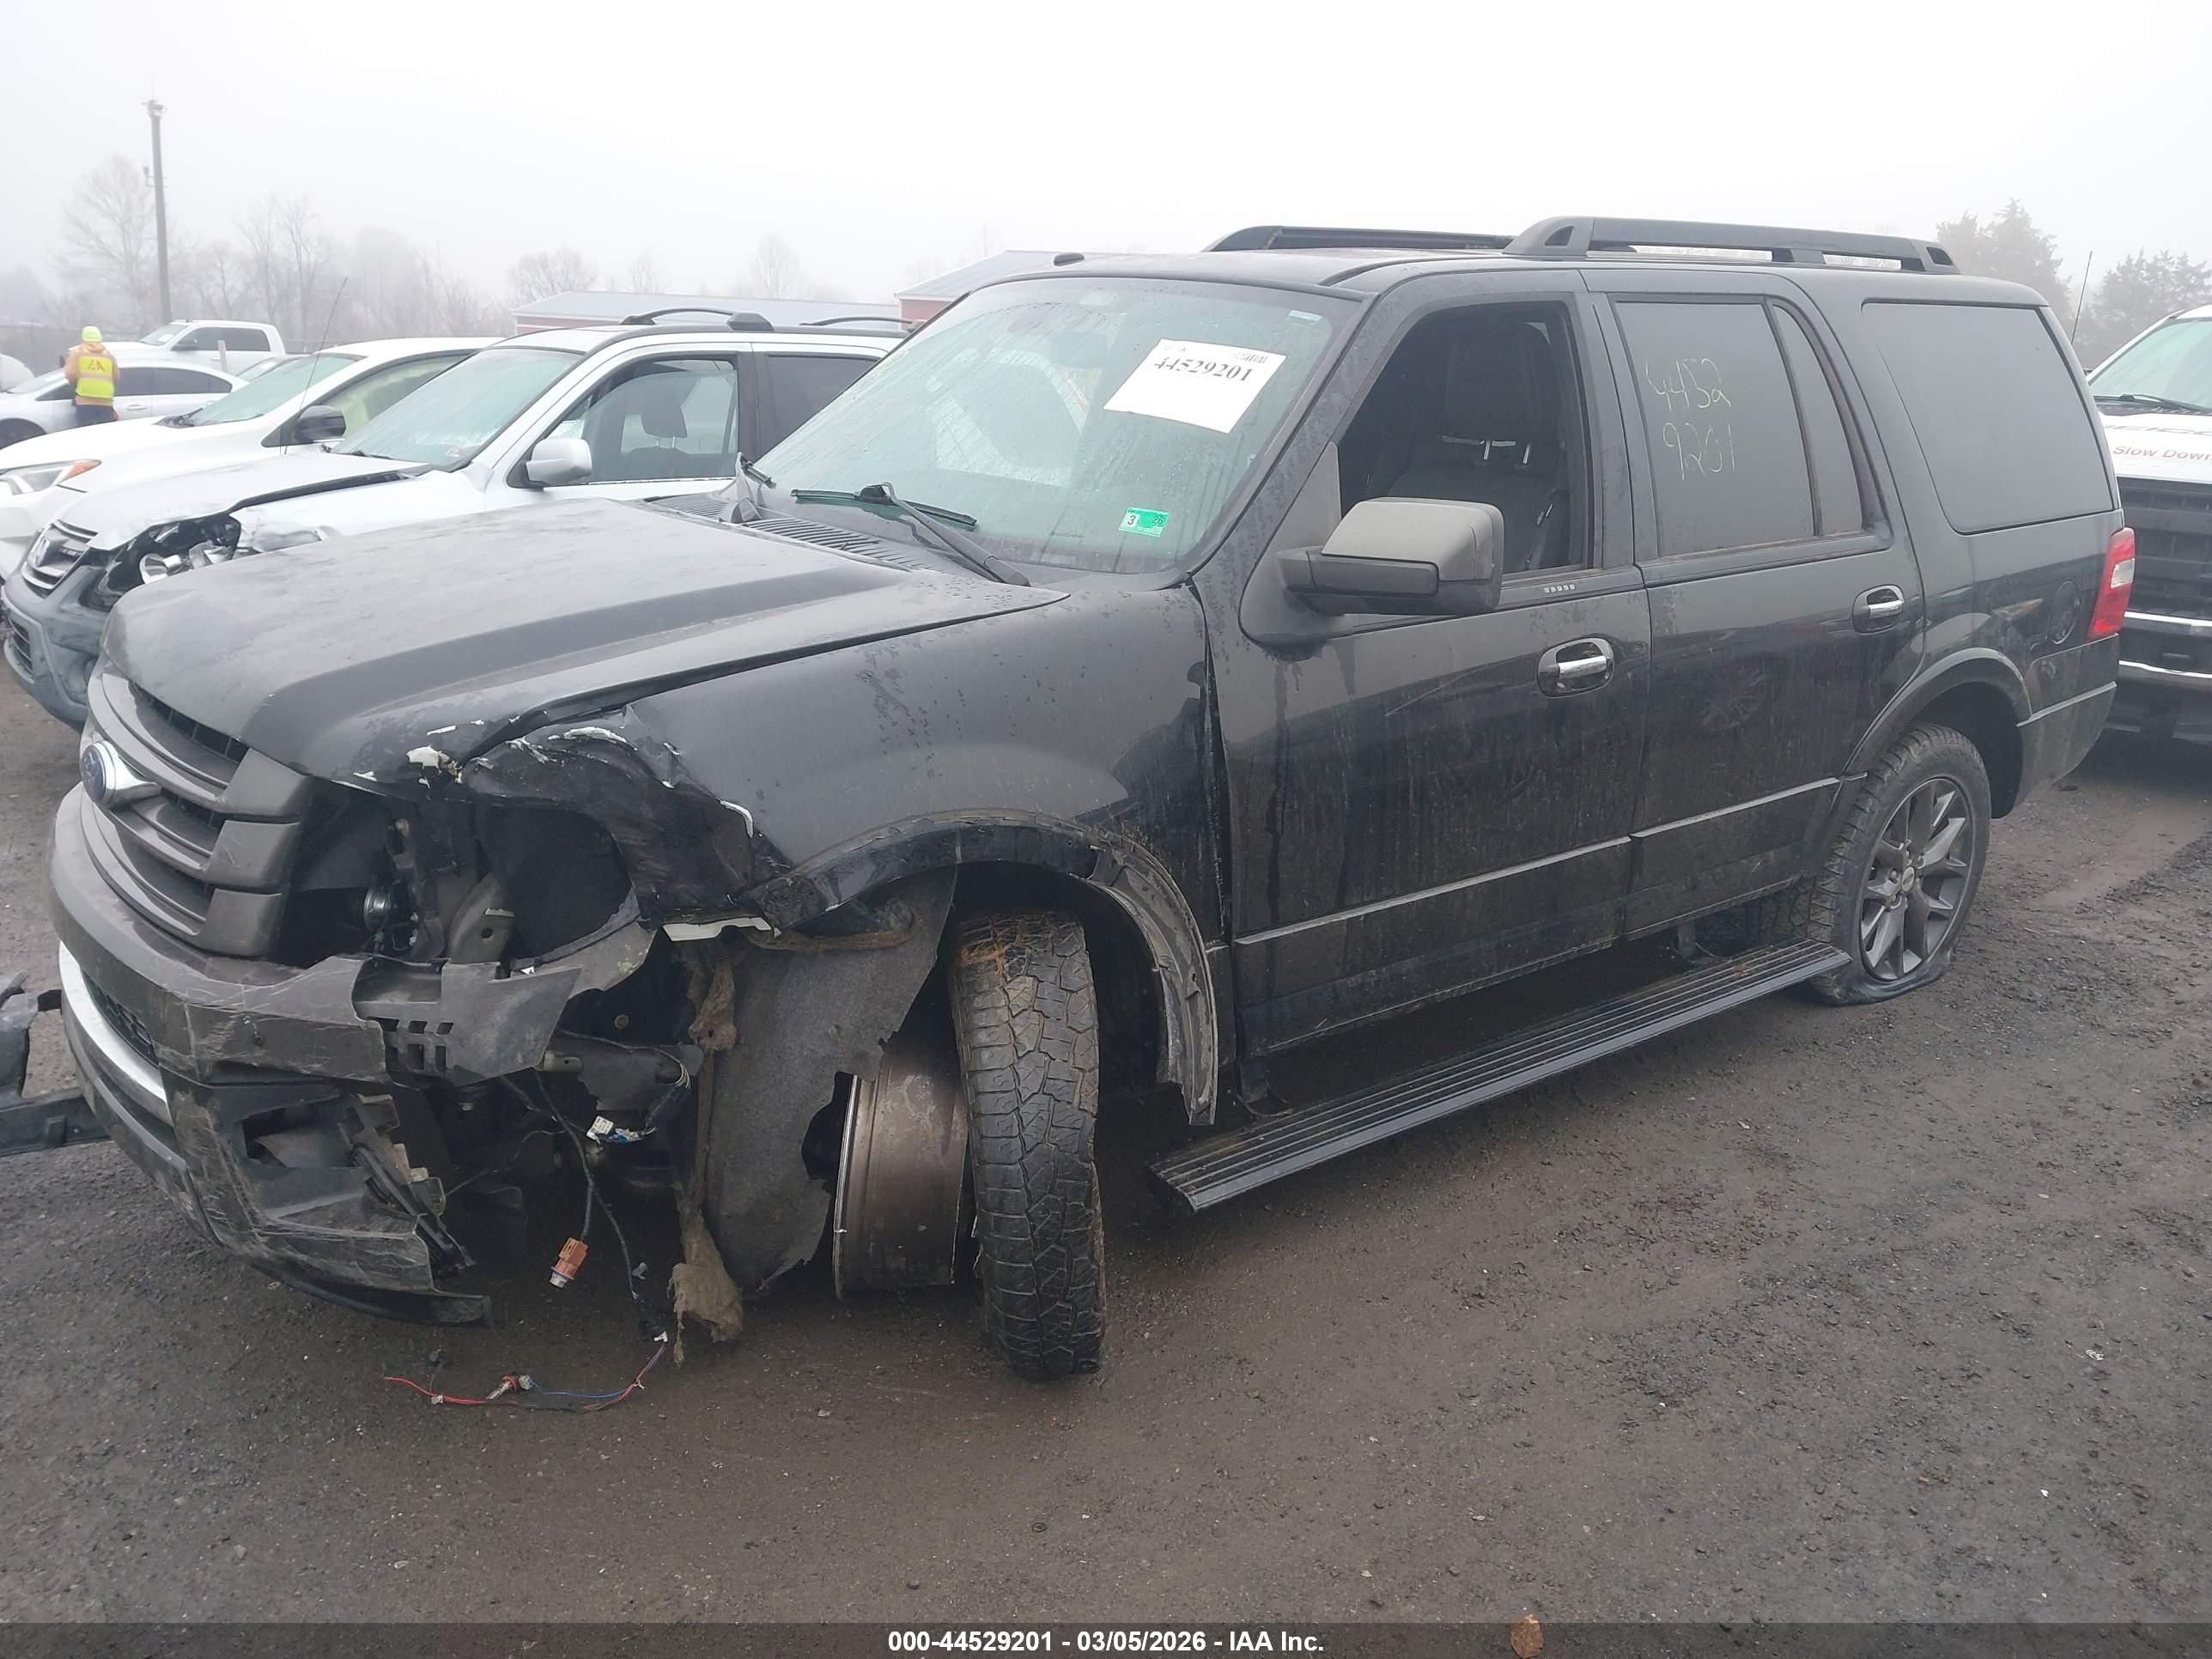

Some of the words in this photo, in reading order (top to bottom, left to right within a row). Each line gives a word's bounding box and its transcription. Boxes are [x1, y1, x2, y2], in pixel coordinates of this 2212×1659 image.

[1154, 356, 1253, 381] 44529201
[1644, 357, 1732, 411] 4452
[1662, 422, 1735, 481] 9201
[2112, 447, 2158, 457] Slow
[1127, 514, 1137, 526] 3
[1152, 514, 1165, 525] 26
